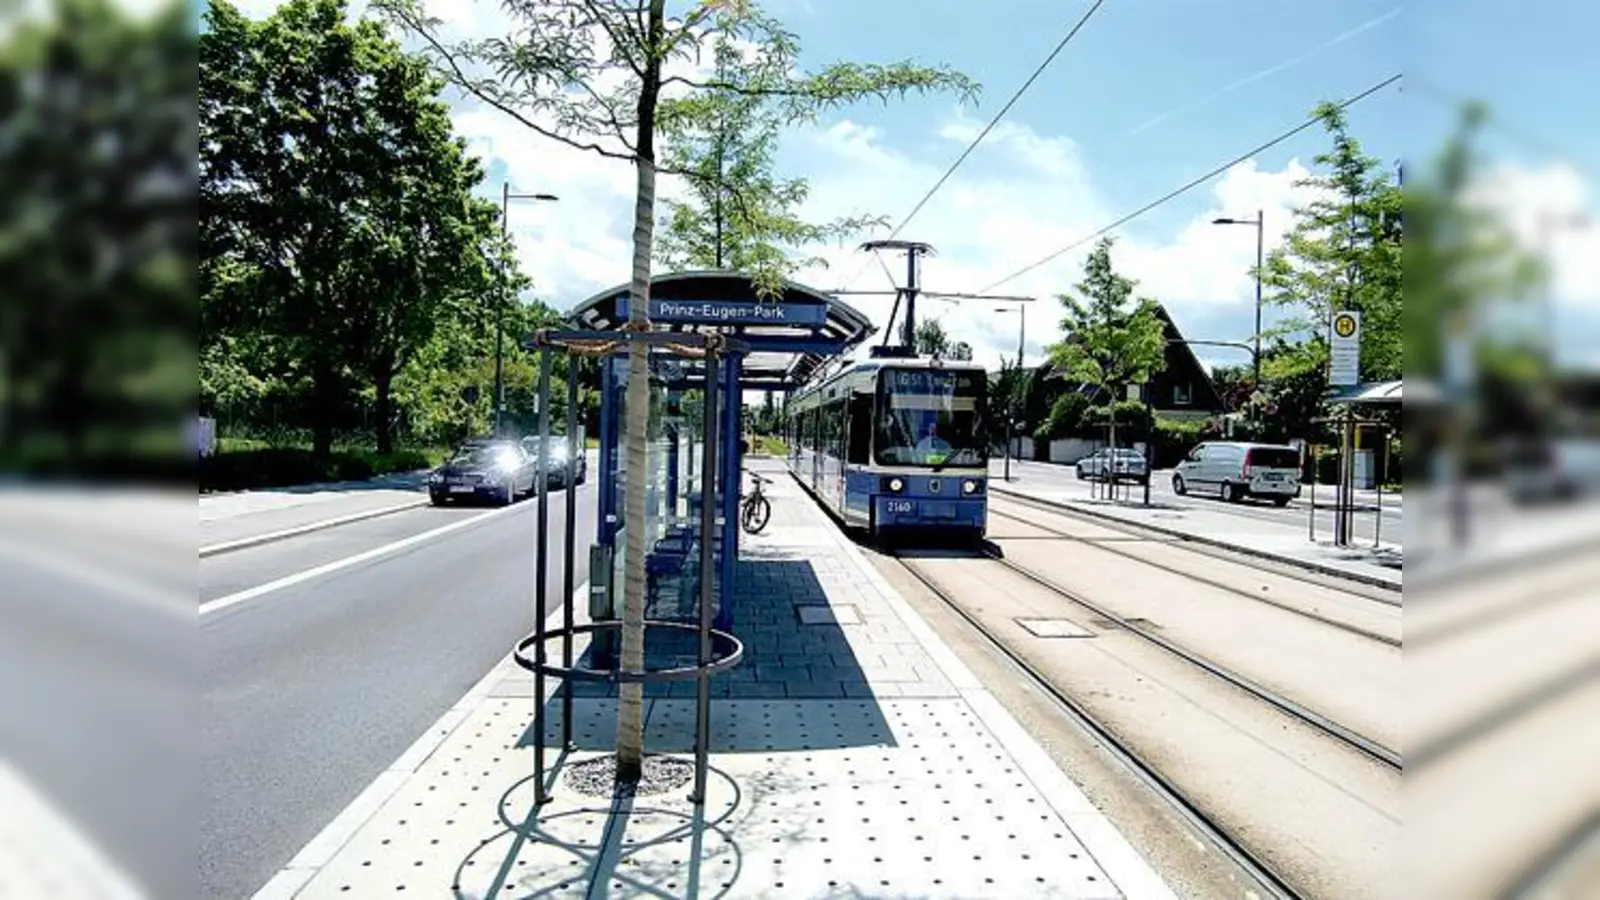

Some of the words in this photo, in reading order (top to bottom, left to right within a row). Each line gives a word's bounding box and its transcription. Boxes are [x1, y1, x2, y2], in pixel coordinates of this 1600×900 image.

[660, 302, 785, 319] Prinz-Eugen-Park
[1339, 319, 1350, 332] H
[888, 502, 911, 512] 2160
